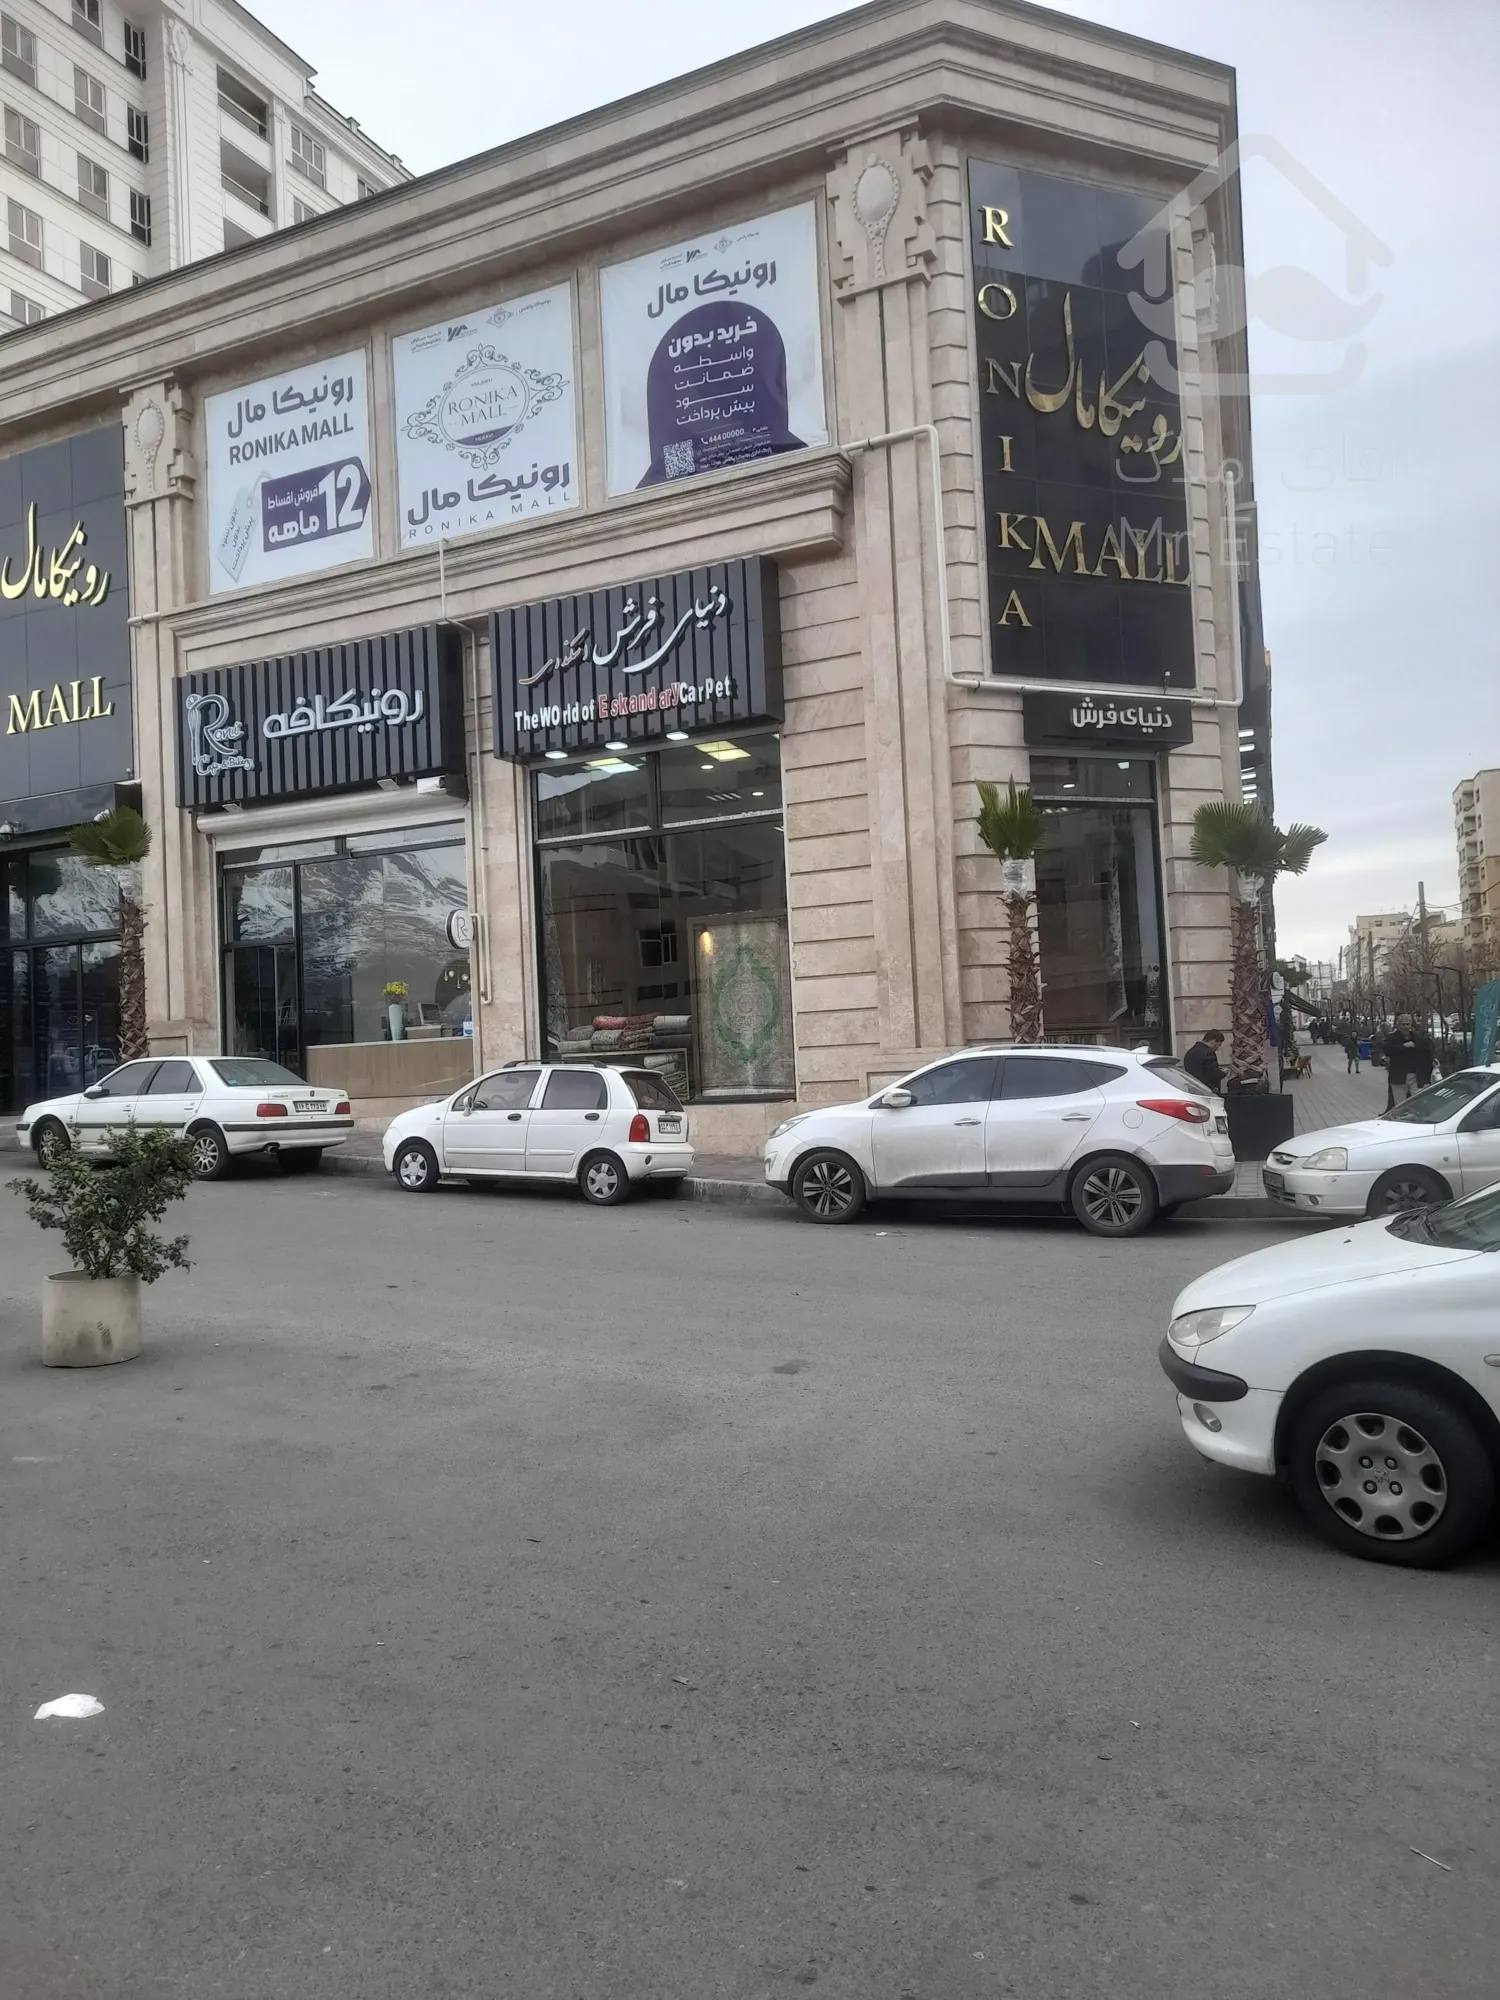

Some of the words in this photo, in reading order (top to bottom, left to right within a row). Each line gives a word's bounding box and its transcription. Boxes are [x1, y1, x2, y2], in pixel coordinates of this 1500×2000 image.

[693, 259, 777, 296] رونیکا
[647, 282, 689, 319] مال
[668, 330, 714, 358] بدون
[717, 315, 758, 344] خرید
[673, 346, 754, 374] واسطه
[674, 363, 754, 391] ضمانت
[272, 375, 353, 415] رونیکا
[448, 385, 518, 415] RONIKA
[675, 383, 754, 409] سود
[722, 399, 755, 418] پیش
[227, 398, 266, 439] مال
[461, 403, 507, 426] MALL
[676, 406, 721, 425] پرداخت
[978, 204, 1032, 628] RONIKA
[229, 428, 300, 465] RONIKA
[301, 412, 354, 445] MALL
[293, 485, 318, 507] فروش
[318, 463, 363, 530] 12
[466, 462, 570, 502] رونیکا
[267, 490, 294, 510] اقساط
[407, 487, 461, 526] مال
[408, 510, 495, 539] RONIKA
[511, 491, 570, 514] MALL
[268, 509, 320, 544] ماهه
[1028, 515, 1191, 587] MALL
[592, 596, 657, 666] فرش
[622, 585, 727, 673] دنیای
[6, 675, 114, 736] MALL
[514, 710, 539, 732] The
[581, 699, 595, 721] of
[1072, 696, 1117, 729] فرش
[1120, 706, 1173, 733] دنیای
